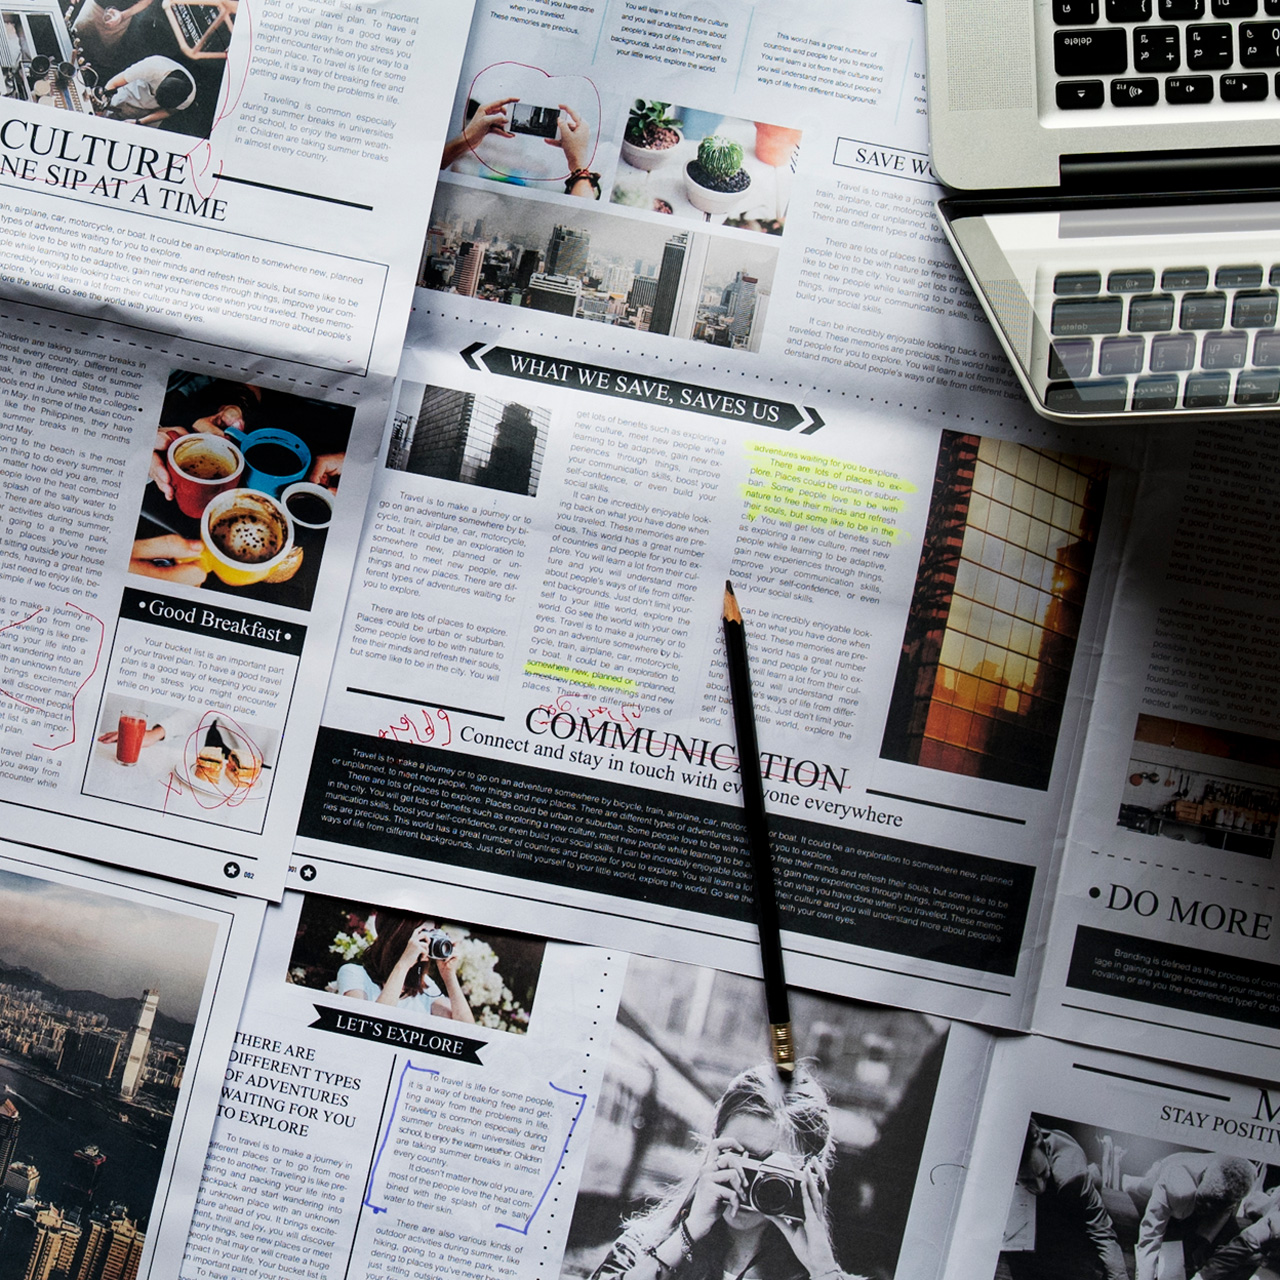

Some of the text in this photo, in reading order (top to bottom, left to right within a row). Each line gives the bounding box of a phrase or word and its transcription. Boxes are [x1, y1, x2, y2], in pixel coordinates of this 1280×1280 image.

[1064, 36, 1093, 46] delete
[0, 119, 190, 185] CULTURE
[855, 148, 906, 171] SAVE
[0, 154, 228, 222] NE SIP AT A TIME
[510, 354, 780, 423] WHAT WE SAVE, SAVES US
[576, 410, 591, 419] get
[591, 412, 606, 422] lots
[617, 417, 648, 430] benefits
[649, 424, 670, 434] such
[670, 429, 681, 437] as
[682, 431, 720, 446] exploring
[753, 445, 900, 480] adventures waiting for you to explore.
[149, 599, 282, 643] Good Breakfast
[144, 636, 285, 675] Your bucket list is an important part
[525, 706, 850, 794] COMMUNICTION
[460, 725, 529, 753] Connect
[533, 744, 565, 760] and
[568, 750, 604, 771] stay
[608, 753, 624, 772] in
[629, 760, 675, 782] touch
[681, 770, 718, 790] with
[804, 797, 903, 828] everywhere
[1106, 883, 1159, 917] DO
[1167, 896, 1273, 941] MORE
[336, 1014, 464, 1055] LET'S EXPLORE
[283, 1044, 316, 1062] ARE
[245, 1074, 349, 1108] ADVENTURES
[314, 1069, 361, 1091] TYPES
[429, 1072, 555, 1109] To travel is life for some people,
[239, 1110, 309, 1137] EXPLORE
[288, 1102, 319, 1121] FOR
[323, 1110, 356, 1128] YOU
[1160, 1105, 1210, 1129] STAY
